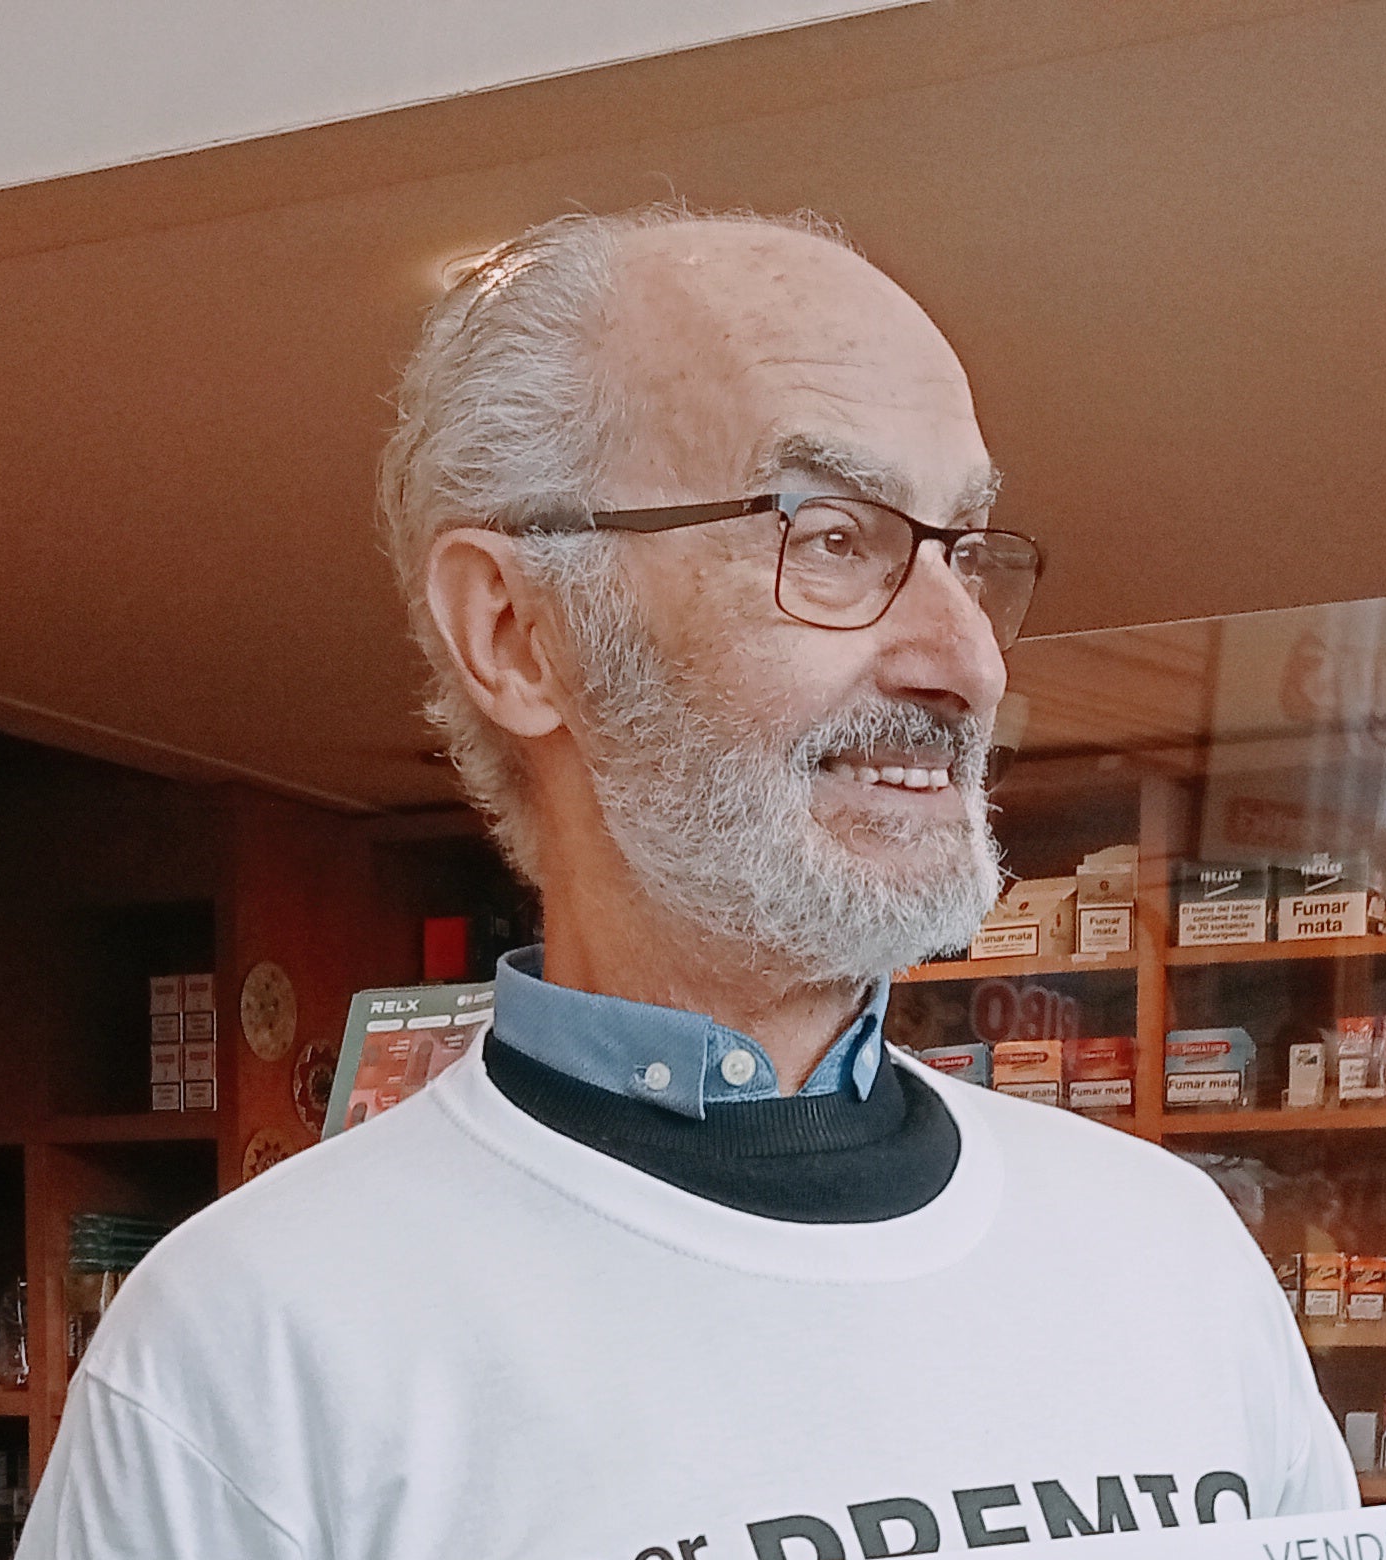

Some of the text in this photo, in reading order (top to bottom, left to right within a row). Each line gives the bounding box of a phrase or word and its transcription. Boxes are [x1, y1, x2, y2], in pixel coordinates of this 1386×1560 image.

[1292, 900, 1350, 917] Fumar
[1088, 915, 1121, 925] Fumar
[1297, 918, 1343, 935] mata
[1007, 931, 1033, 942] mata
[1092, 926, 1118, 936] mata
[370, 998, 420, 1014] RELX
[1168, 1075, 1240, 1090] Fumar mata
[1070, 1085, 1130, 1096] Fumar mata
